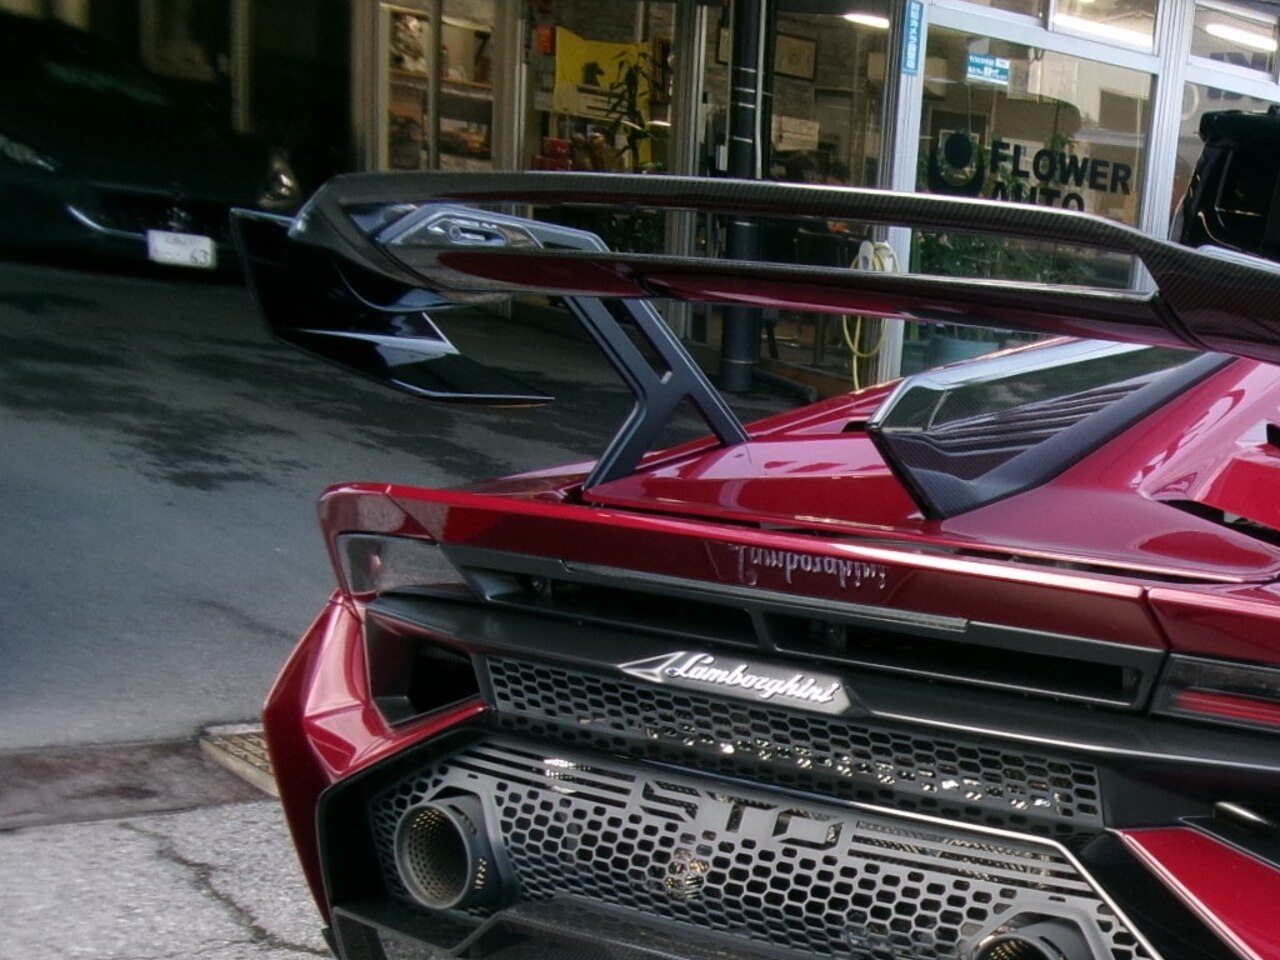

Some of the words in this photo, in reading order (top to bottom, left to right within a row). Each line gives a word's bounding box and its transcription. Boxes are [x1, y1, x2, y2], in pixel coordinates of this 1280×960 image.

[989, 140, 1132, 196] FLOWER
[664, 651, 841, 705] Lamborghini
[641, 779, 845, 851] STO
